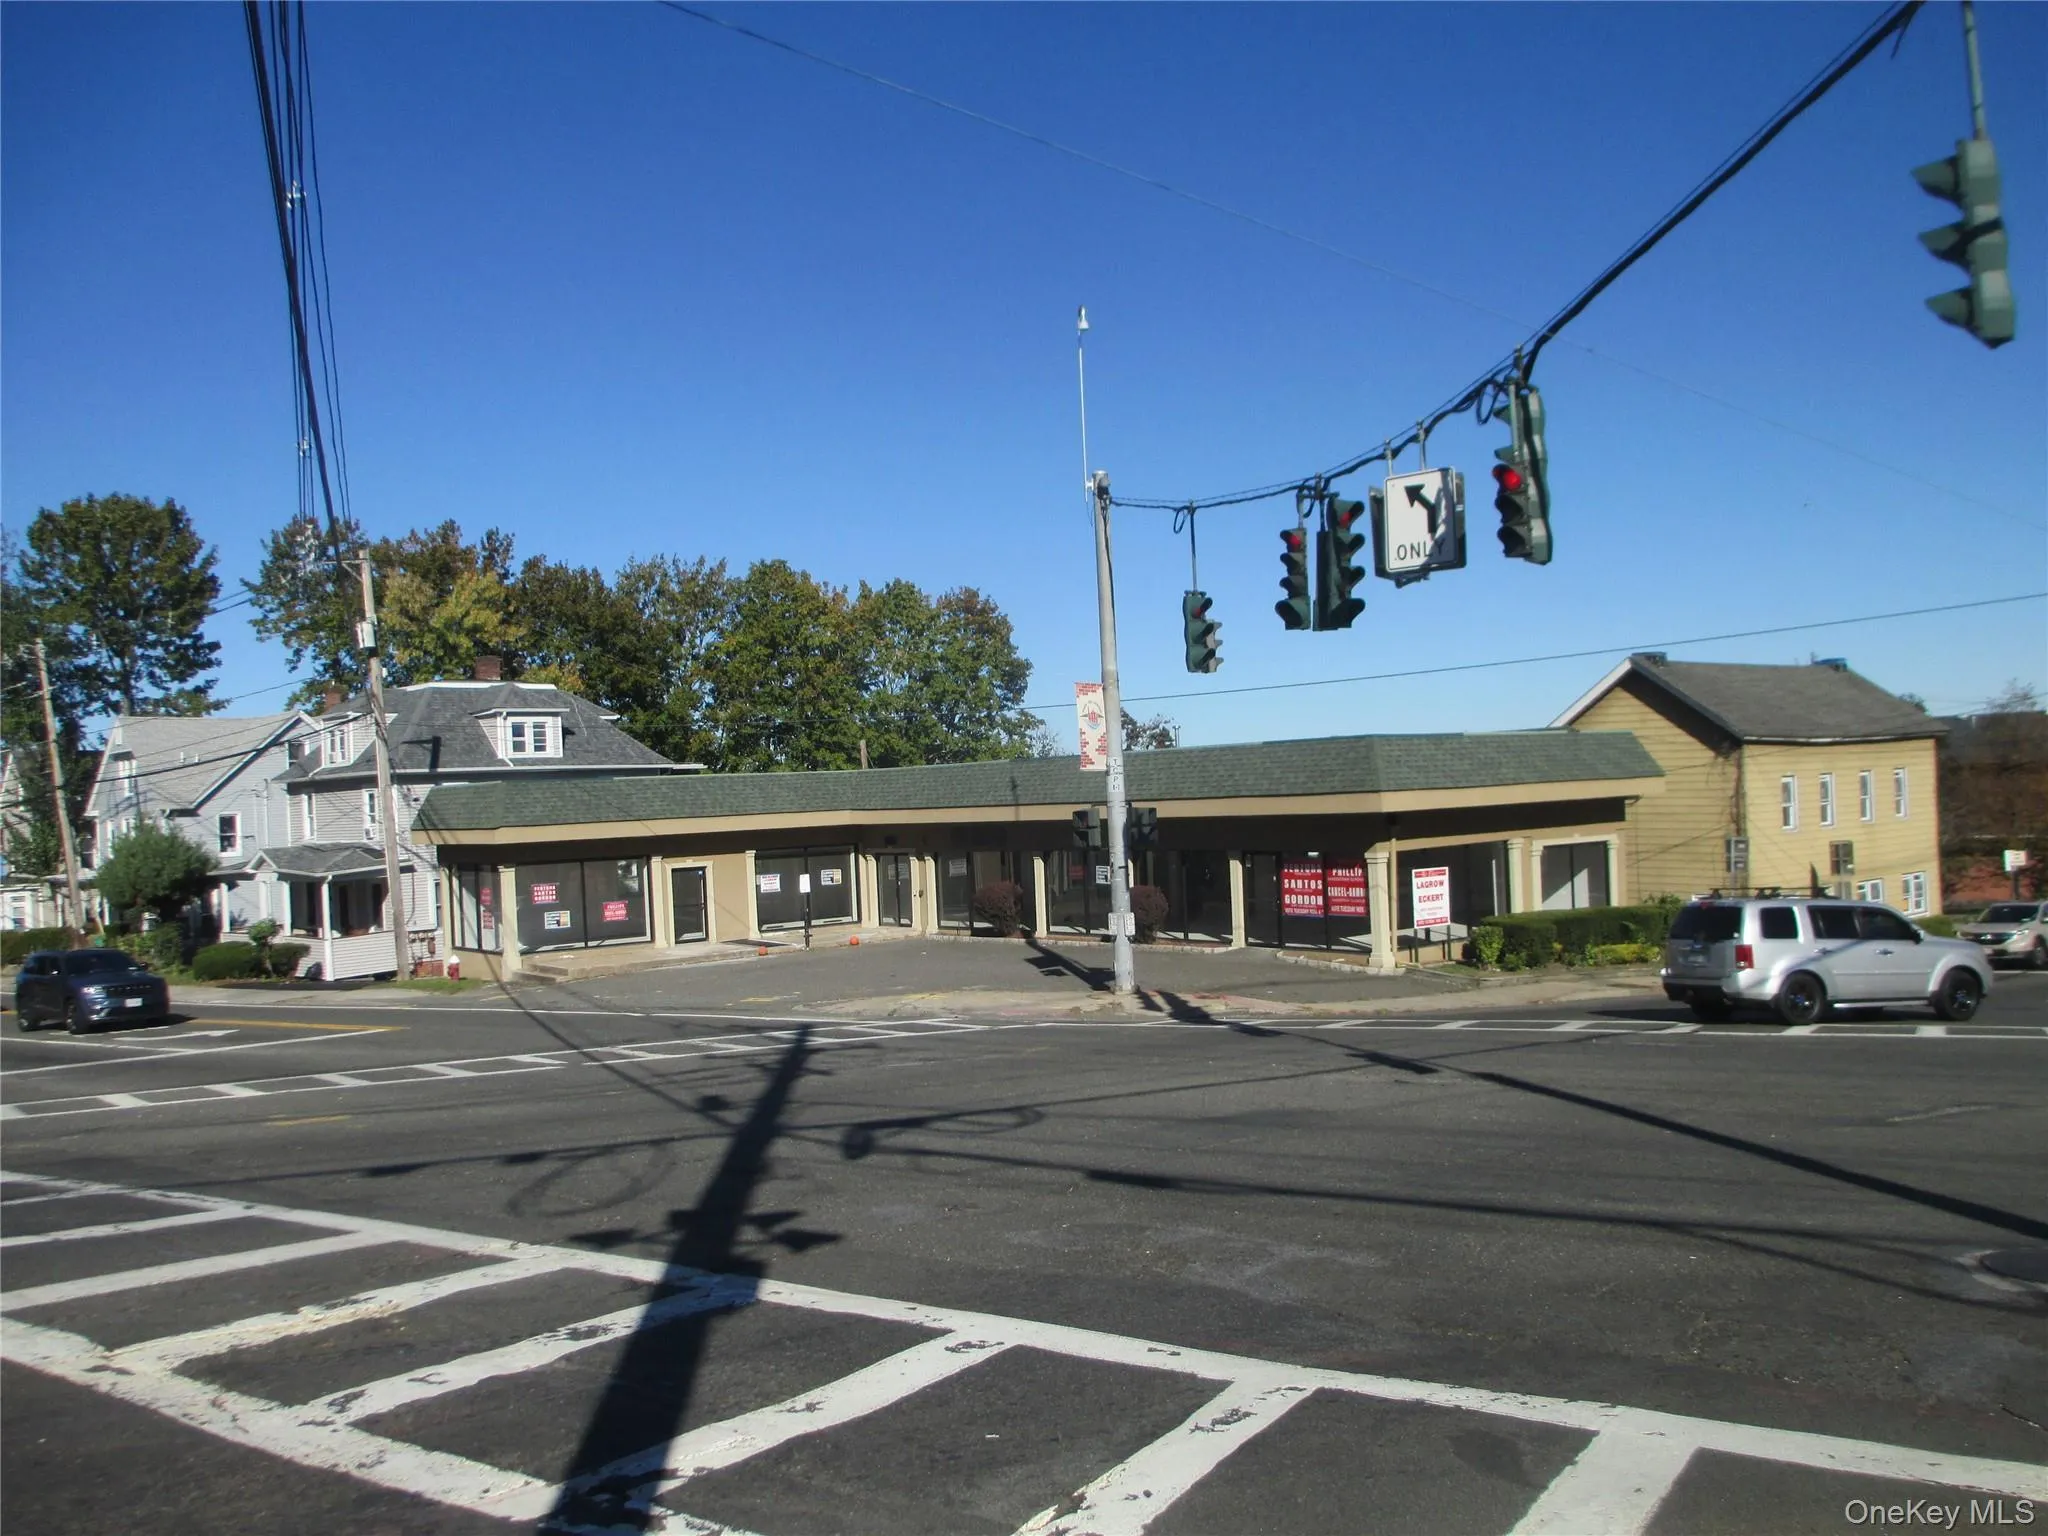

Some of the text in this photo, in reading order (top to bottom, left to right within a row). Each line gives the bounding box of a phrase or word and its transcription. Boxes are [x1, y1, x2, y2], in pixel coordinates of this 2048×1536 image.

[1396, 538, 1446, 561] ONLY
[1284, 879, 1323, 889] SANTOS
[1416, 880, 1444, 889] LAGROW
[1284, 894, 1324, 905] GORDON
[1418, 893, 1444, 903] ECKERT
